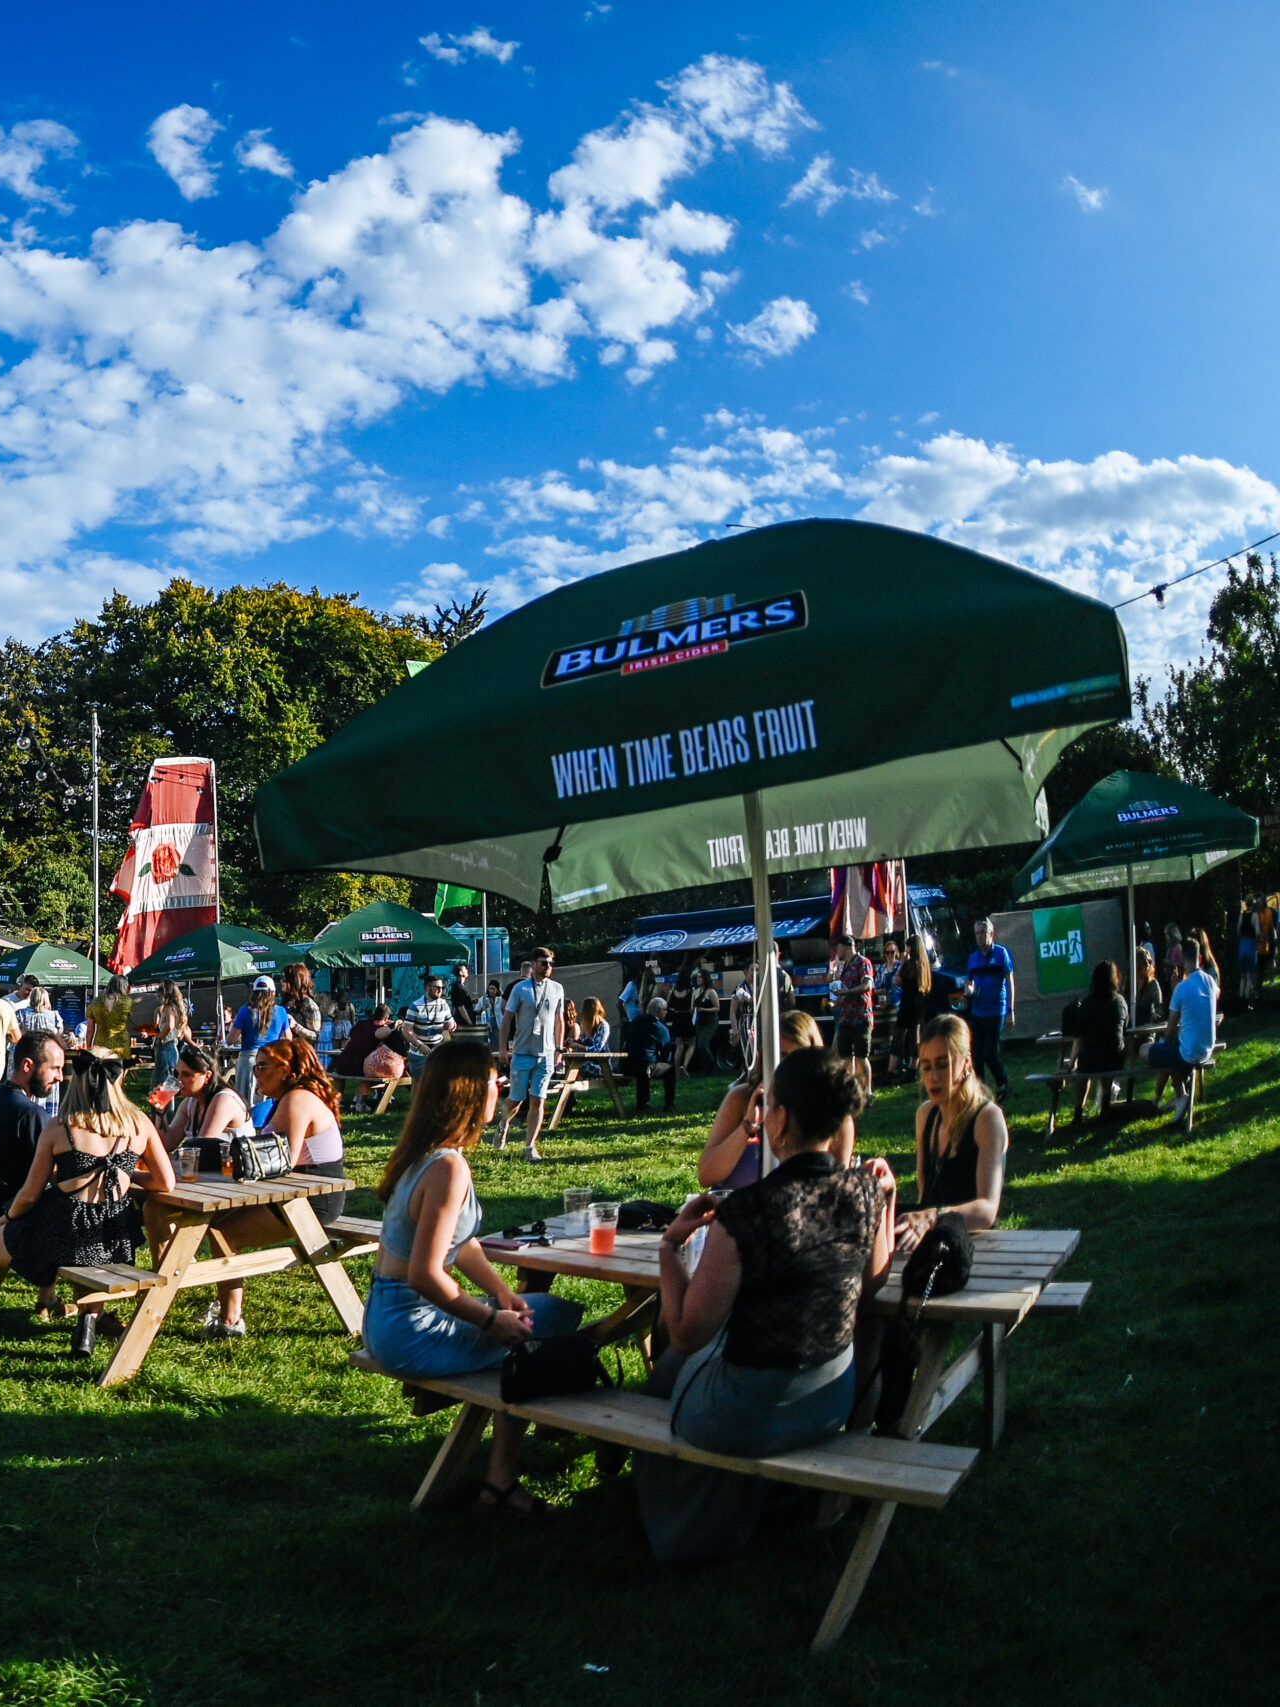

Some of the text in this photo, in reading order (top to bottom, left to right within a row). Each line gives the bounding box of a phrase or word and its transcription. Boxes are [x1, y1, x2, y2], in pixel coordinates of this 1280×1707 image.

[554, 600, 796, 677] BULMERS
[629, 644, 719, 671] IRISH CIDER
[551, 700, 817, 798] WHEN TIME BEARS FRUIT
[1117, 805, 1179, 823] BULMERS
[361, 932, 410, 940] BULMERS
[709, 919, 793, 937] BURER
[1040, 940, 1067, 958] EXIT
